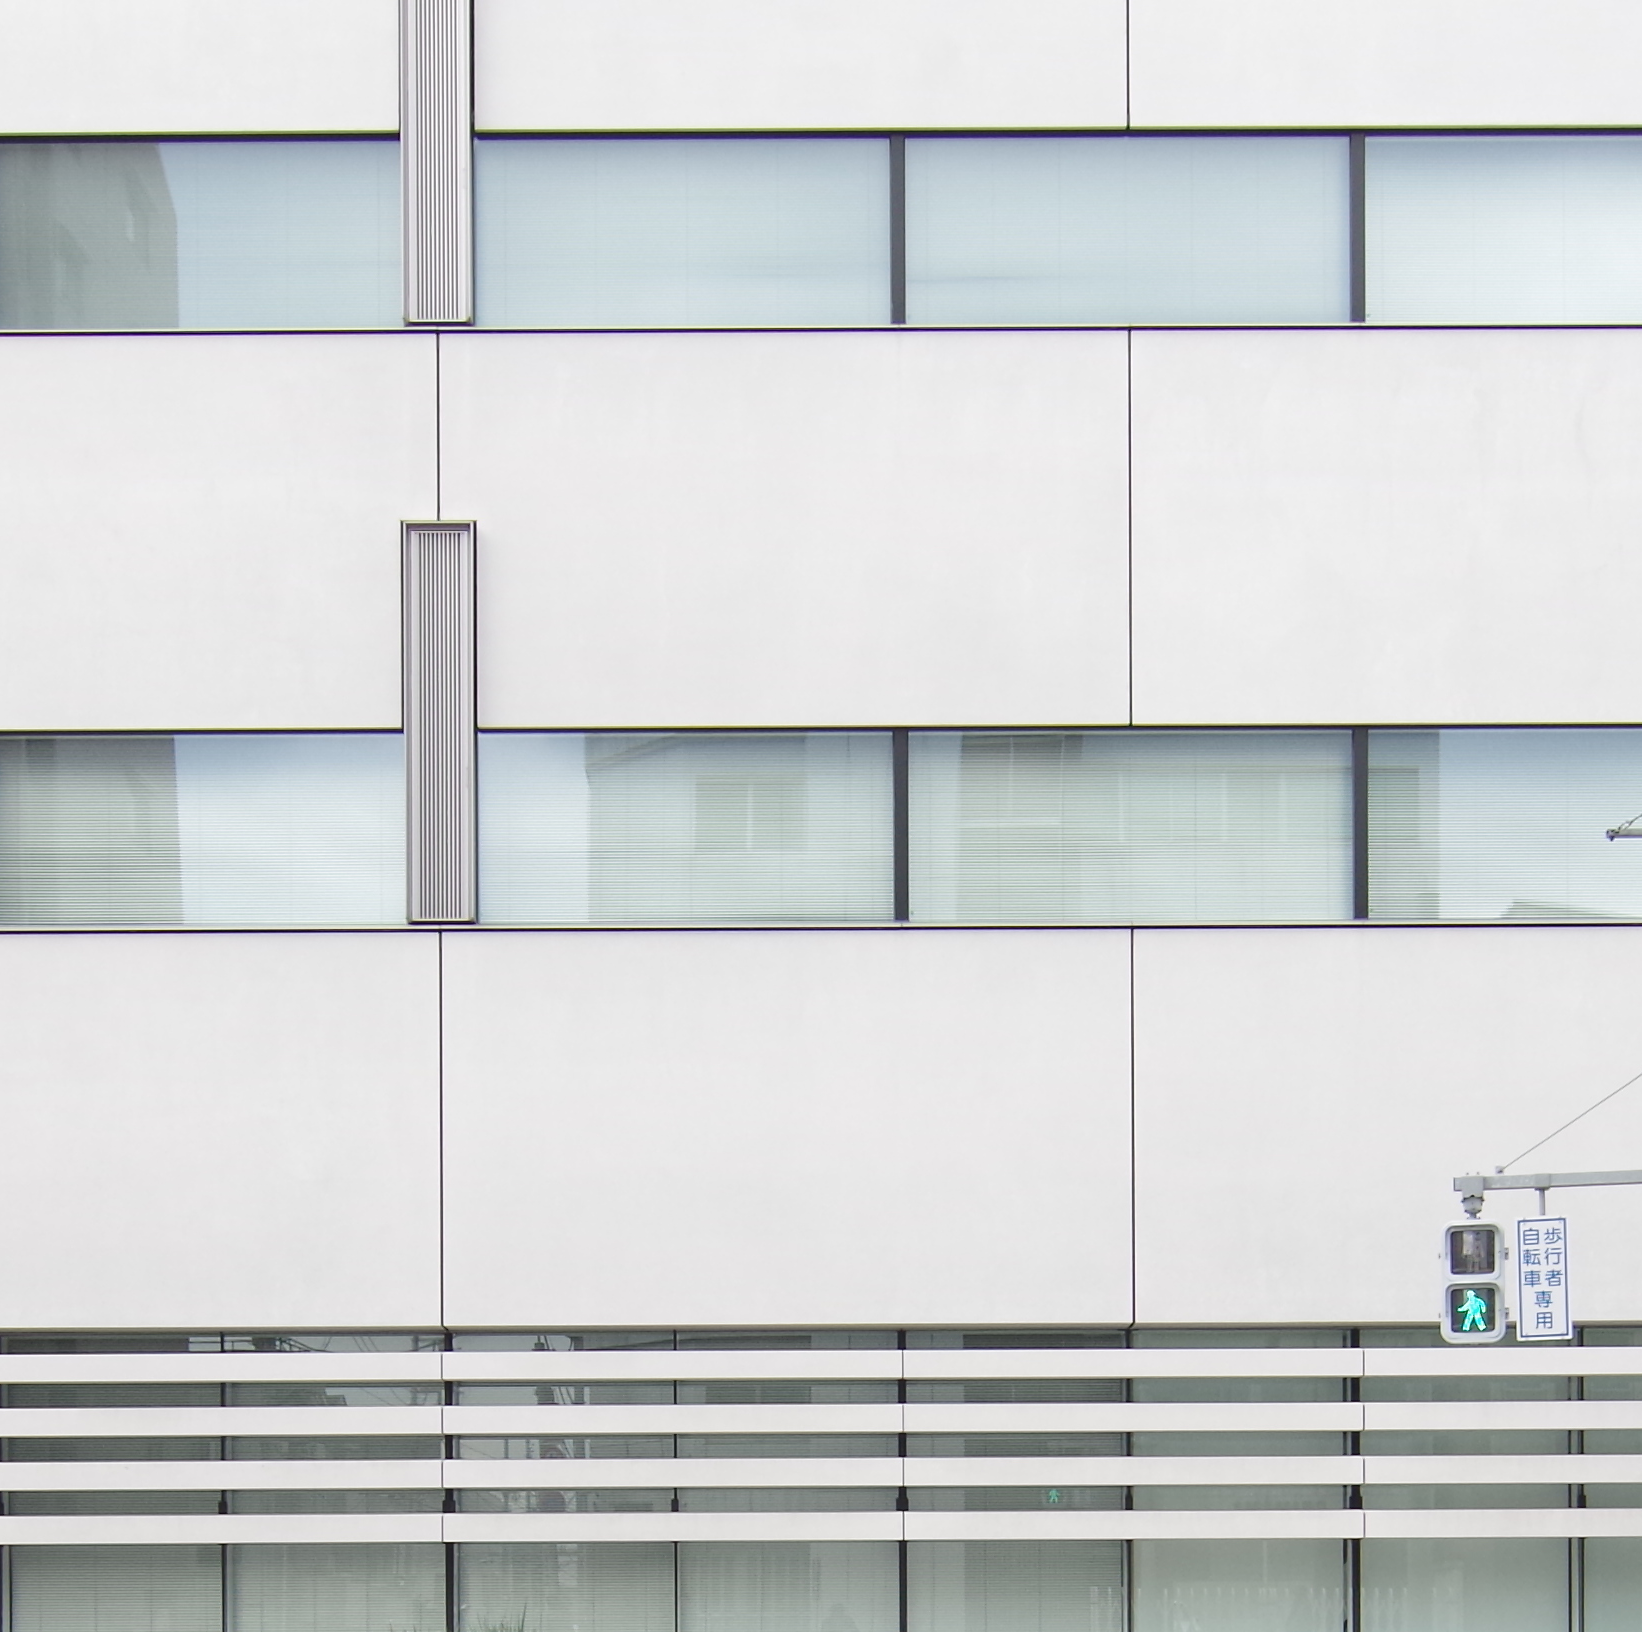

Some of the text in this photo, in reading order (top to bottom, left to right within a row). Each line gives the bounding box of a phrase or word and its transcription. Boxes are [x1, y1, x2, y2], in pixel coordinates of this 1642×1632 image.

[1522, 1227, 1542, 1288] 自転車
[1544, 1227, 1563, 1287] 歩行者
[1534, 1290, 1553, 1329] 専用
